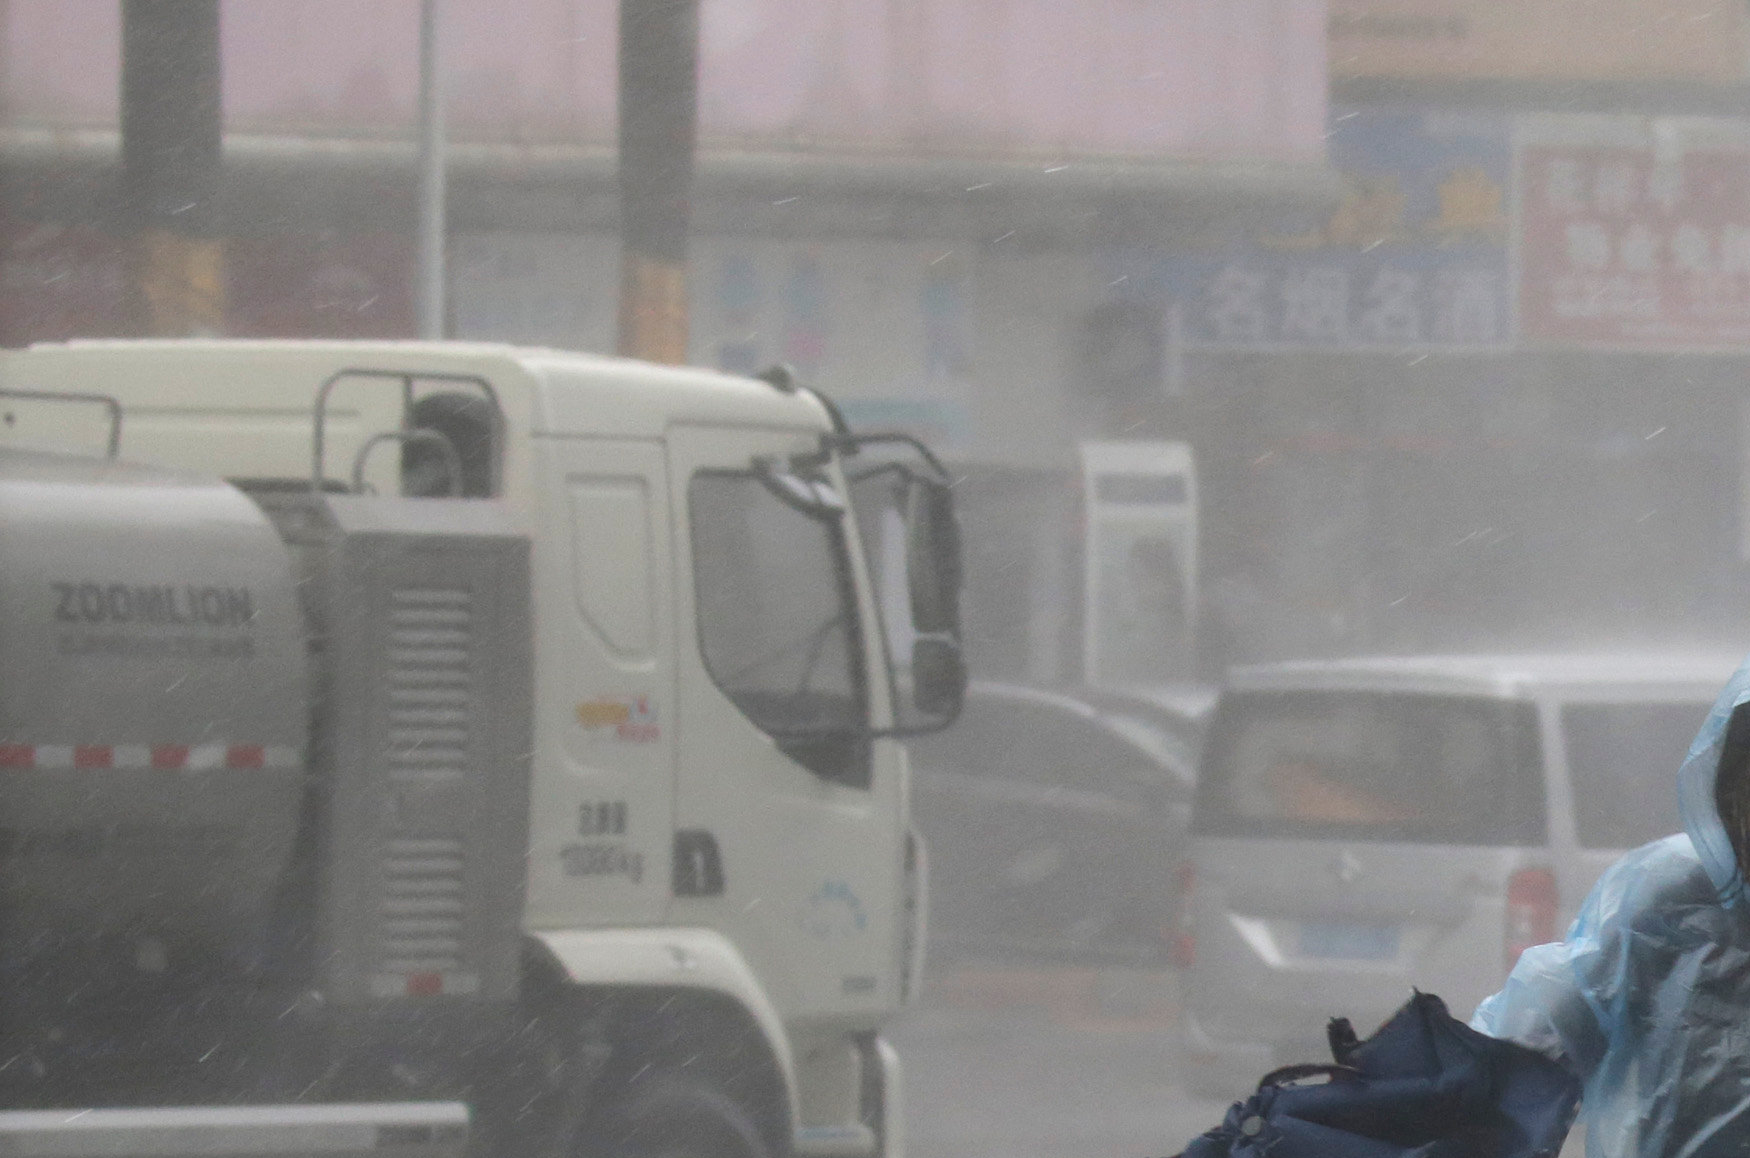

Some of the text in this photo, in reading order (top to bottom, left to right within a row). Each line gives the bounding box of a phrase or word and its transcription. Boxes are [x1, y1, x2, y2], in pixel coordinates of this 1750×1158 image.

[1207, 264, 1498, 342] 名烟名酒
[53, 583, 252, 625] ZOOMLION
